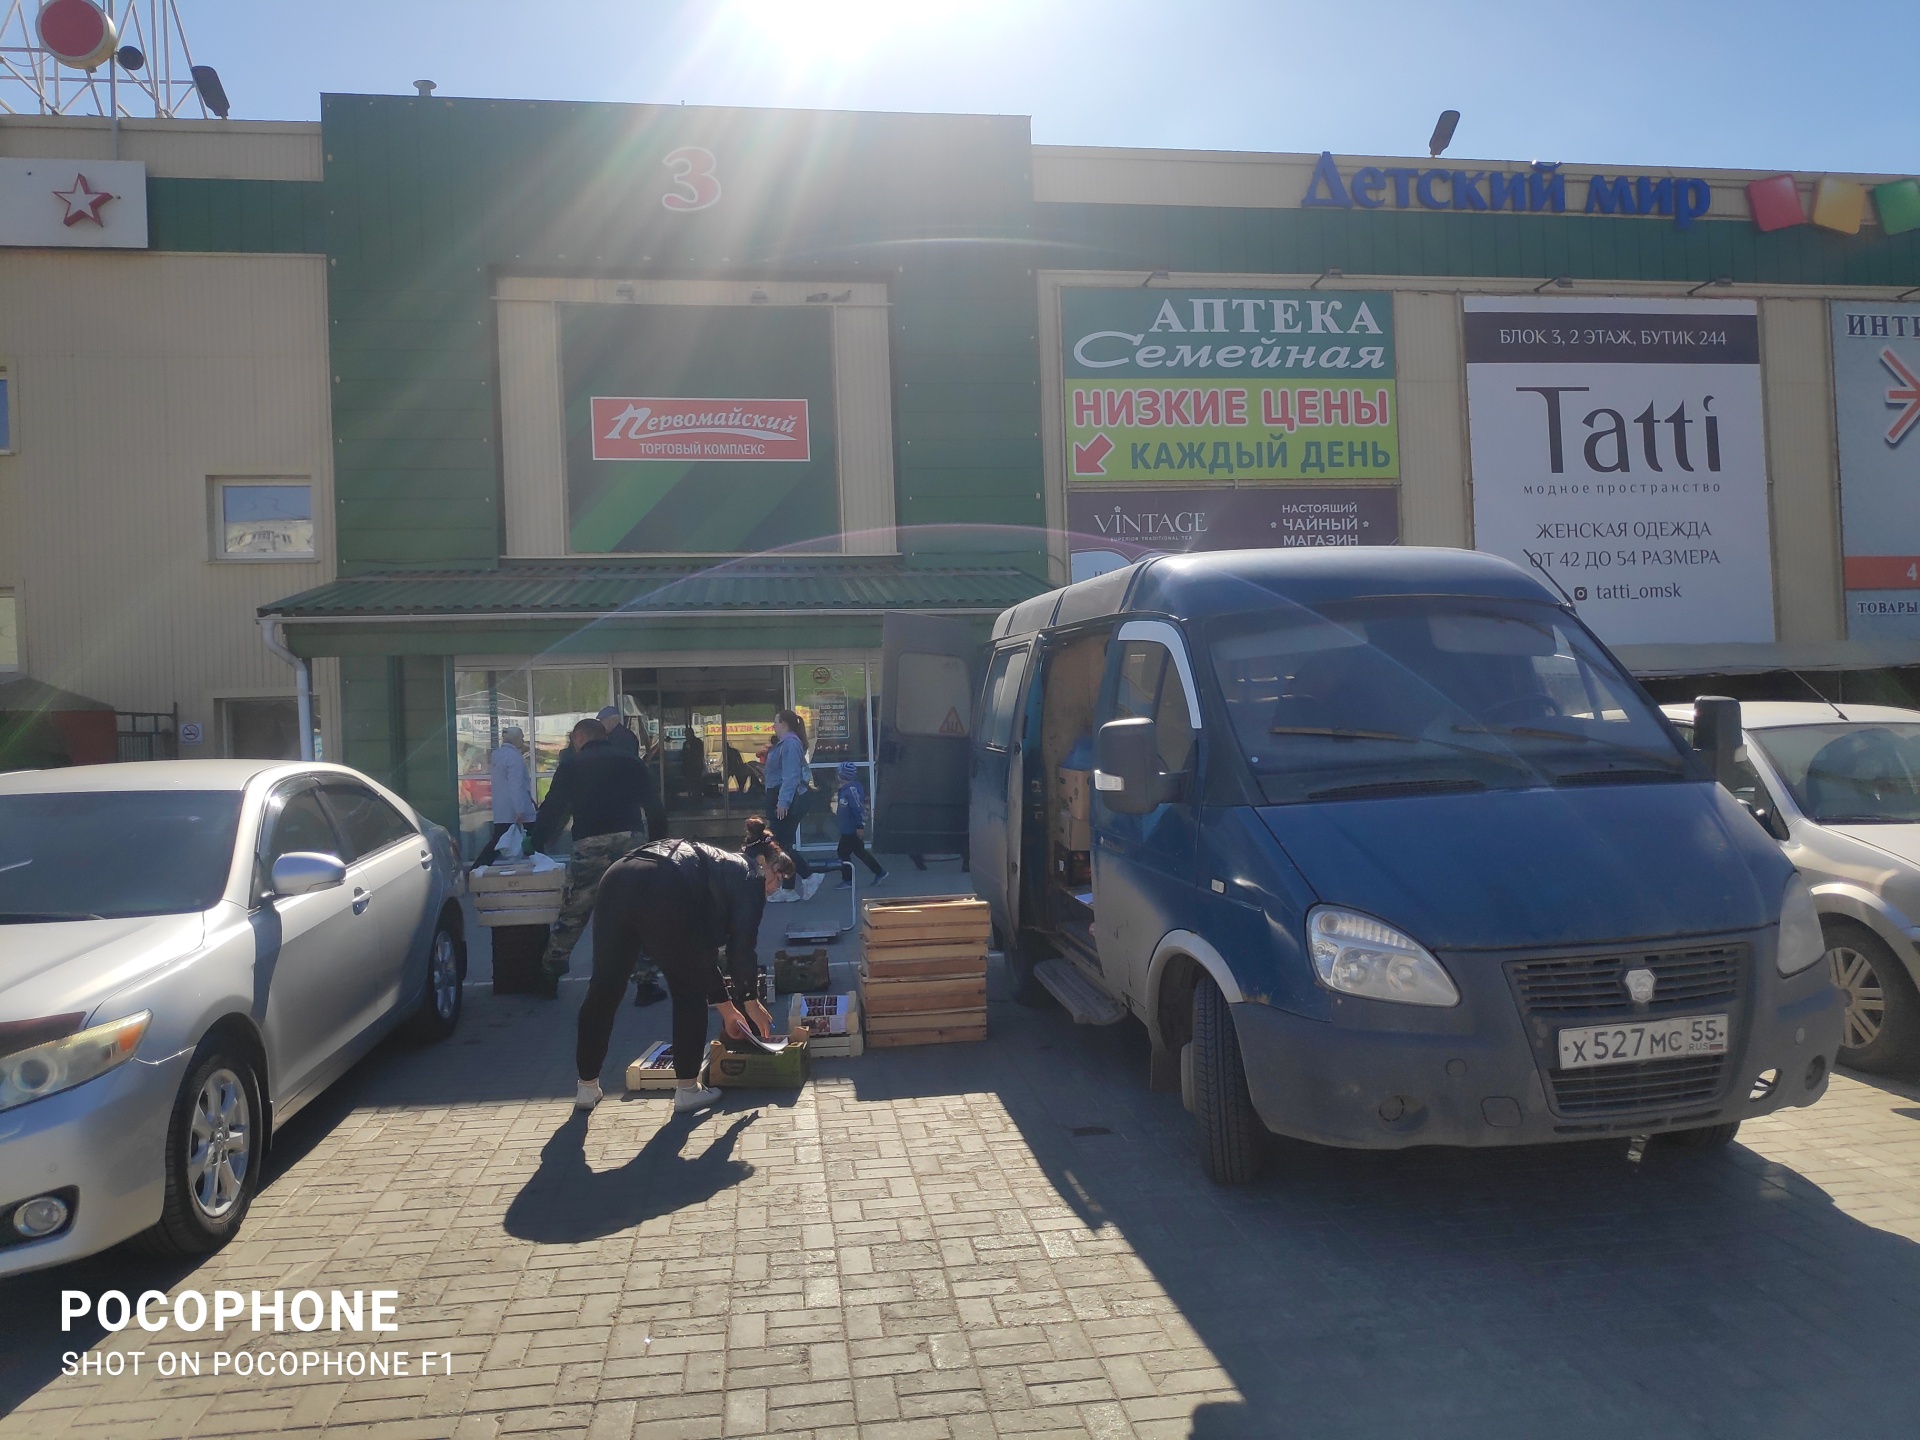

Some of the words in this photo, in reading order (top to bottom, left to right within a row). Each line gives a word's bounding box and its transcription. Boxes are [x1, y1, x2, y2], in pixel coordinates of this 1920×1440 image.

[661, 146, 722, 211] 3
[1304, 151, 1566, 213] Детский
[1585, 174, 1711, 229] мир
[1149, 298, 1383, 334] АПТЕКА
[1500, 329, 1548, 345] БЛОК
[1552, 330, 1566, 346] 3,
[1570, 329, 1580, 344] 2
[1583, 330, 1637, 346] ЭТАЖ,
[1641, 330, 1695, 346] БУТИК
[1699, 331, 1727, 346] 244
[1073, 331, 1385, 369] Семейная
[604, 402, 798, 440] Первомайский
[1073, 389, 1249, 428] НИЗКИЕ
[1261, 389, 1390, 433] ЦЕНЫ
[1516, 386, 1721, 473] Tatti
[640, 442, 701, 455] ТОРГОВЫЙ
[704, 443, 766, 455] КОМПЛЕКС
[1131, 433, 1287, 474] КАЖДЫЙ
[1300, 441, 1391, 473] ДЕНЬ
[1523, 484, 1590, 496] модное
[1597, 483, 1721, 496] пространство
[1282, 502, 1357, 514] НАСТОЯЩИЙ
[1094, 506, 1208, 534] VINTAGE
[1282, 515, 1358, 531] ЧАЙНЫЙ
[1536, 522, 1628, 539] ЖЕНСКАЯ
[1633, 521, 1712, 540] ОДЕЖДА
[1283, 534, 1358, 546] МАГАЗИН
[1530, 552, 1554, 568] ОТ
[1559, 552, 1581, 567] 42
[1584, 552, 1612, 570] ДО
[1617, 551, 1637, 566] 54
[1642, 549, 1721, 565] РАЗМЕРА
[1596, 583, 1682, 600] tatti_omsk
[1858, 602, 1919, 613] ТОВАРЫ
[1691, 1020, 1717, 1042] 55
[1689, 1042, 1709, 1051] RUS
